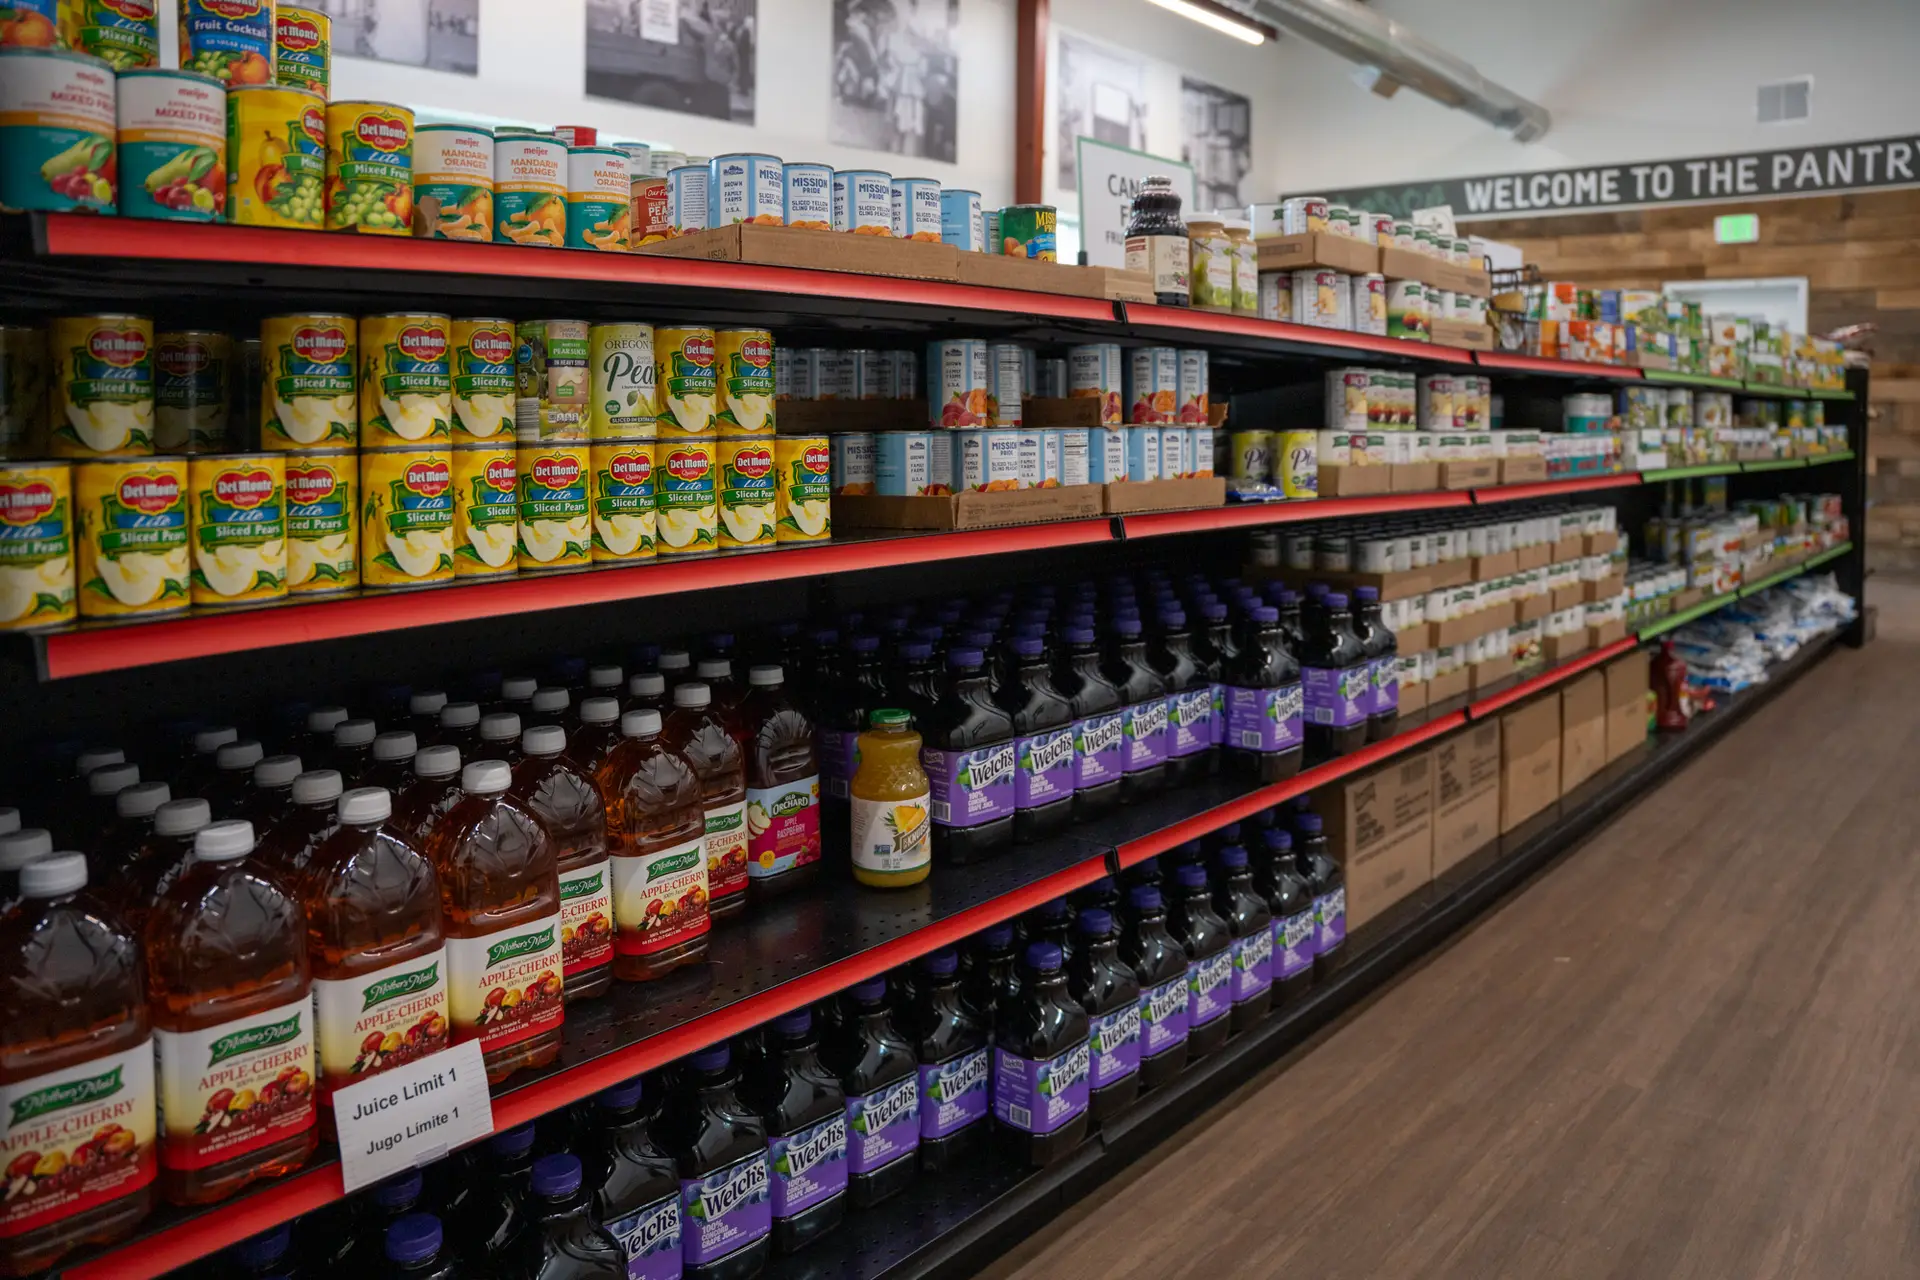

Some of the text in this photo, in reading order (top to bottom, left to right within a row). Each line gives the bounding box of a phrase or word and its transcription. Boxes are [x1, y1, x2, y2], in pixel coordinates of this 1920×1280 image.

[195, 20, 267, 39] Fruit Cocktail
[288, 26, 319, 40] Monte
[99, 29, 135, 44] Mixed
[280, 50, 310, 62] Lite
[301, 65, 322, 78] Fruit
[50, 91, 95, 106] MIXED
[155, 108, 196, 121] MIXED
[360, 123, 408, 140] Del Monte
[456, 137, 480, 149] meijer
[368, 151, 401, 165] Lite
[441, 148, 489, 161] MANDARIN
[523, 147, 549, 158] meijer
[444, 158, 487, 171] ORANGES
[511, 158, 558, 170] MANDARIN
[605, 160, 625, 169] meijer
[355, 163, 409, 181] Mixed Fruit
[513, 166, 556, 178] ORANGES
[1465, 169, 1620, 212] WELCOME
[1630, 165, 1674, 200] TO
[1685, 157, 1759, 195] THE
[1771, 140, 1920, 190] PANTR
[792, 177, 828, 188] MISSION
[858, 183, 890, 194] MISSION
[647, 188, 659, 197] Our
[802, 187, 820, 195] PRIDE
[868, 193, 884, 201] PRIDE
[295, 336, 345, 349] Del Monte
[403, 335, 446, 348] Del Monte
[474, 339, 512, 350] Del Monte
[604, 340, 649, 350] OREGON
[686, 345, 700, 355] Del
[744, 346, 758, 356] Del
[304, 362, 340, 375] Lite
[411, 360, 440, 374] Lite
[482, 363, 508, 375] Lite
[692, 367, 713, 378] Lite
[750, 368, 769, 378] Lite
[89, 381, 126, 394] Sliced
[293, 378, 352, 389] Sliced Pears
[400, 376, 432, 387] Sliced
[471, 377, 500, 388] Sliced
[684, 379, 709, 389] Sliced
[743, 379, 763, 389] Sliced
[669, 458, 708, 470] Del Monte
[737, 457, 772, 468] Del Monte
[806, 453, 818, 464] Del
[489, 468, 502, 478] Del
[535, 464, 579, 477] Del Monte
[613, 462, 651, 474] Del Monte
[408, 470, 449, 482] Del Monte
[217, 479, 272, 493] Del Monte
[299, 477, 332, 489] Monte
[676, 480, 703, 492] Lite
[743, 478, 767, 489] Lite
[123, 484, 178, 498] Del Monte
[544, 489, 574, 502] Lite
[620, 485, 646, 497] Lite
[735, 489, 759, 500] Sliced
[804, 485, 824, 495] Sliced
[417, 497, 445, 510] Lite
[611, 497, 655, 508] Sliced Pears
[667, 491, 714, 503] Sliced Pears
[289, 505, 325, 517] Lite
[487, 506, 511, 517] Sliced
[533, 502, 586, 513] Sliced Pears
[132, 515, 172, 528] Lite
[228, 508, 264, 522] Lite
[406, 512, 436, 523] Sliced
[215, 523, 280, 537] Sliced Pears
[314, 519, 342, 531] Pears
[120, 531, 159, 543] Sliced
[33, 540, 64, 555] Pears
[1180, 694, 1210, 722] Welch's
[1276, 689, 1303, 716] Welch's
[1134, 706, 1166, 735] Welch's
[1084, 720, 1120, 752] Welch's
[1034, 736, 1073, 770] Welch's
[971, 749, 1014, 786] Welch's
[772, 797, 808, 815] ORCHARD
[725, 815, 740, 827] Maid
[784, 816, 798, 828] APPLE
[776, 823, 806, 839] RASPBERRY
[652, 853, 698, 878] Mother's Maid
[579, 877, 599, 891] Maid
[640, 870, 705, 900] APPLE-CHERRY
[574, 914, 588, 925] Juice
[493, 933, 551, 961] Mother's Maid
[478, 951, 562, 989] APPLE-CHERRY
[1200, 958, 1231, 993] Welch's
[371, 971, 435, 999] Mother's Maid
[506, 974, 538, 988] 100% Juice
[1151, 985, 1187, 1021] Welch's
[353, 990, 446, 1034] APPLE-CHERRY
[1102, 1012, 1139, 1050] Welch's
[216, 1021, 295, 1058] Mother's Maid
[198, 1042, 310, 1092] APPLE-CHERRY
[1052, 1048, 1089, 1089] Welch's
[942, 1056, 987, 1099] Welch's
[353, 1067, 457, 1121] Juice Limit 1
[866, 1083, 916, 1129] Welch's
[366, 1106, 460, 1155] Jugo Límite 1
[789, 1125, 844, 1172] Welch's
[787, 1175, 806, 1189] 100%
[704, 1162, 766, 1217] Welch's
[786, 1182, 810, 1196] CONCORD
[786, 1182, 819, 1203] GRAPE JUICE
[701, 1226, 729, 1241] CONCORD
[702, 1219, 724, 1235] 100%
[701, 1226, 739, 1248] GRAPE JUICE
